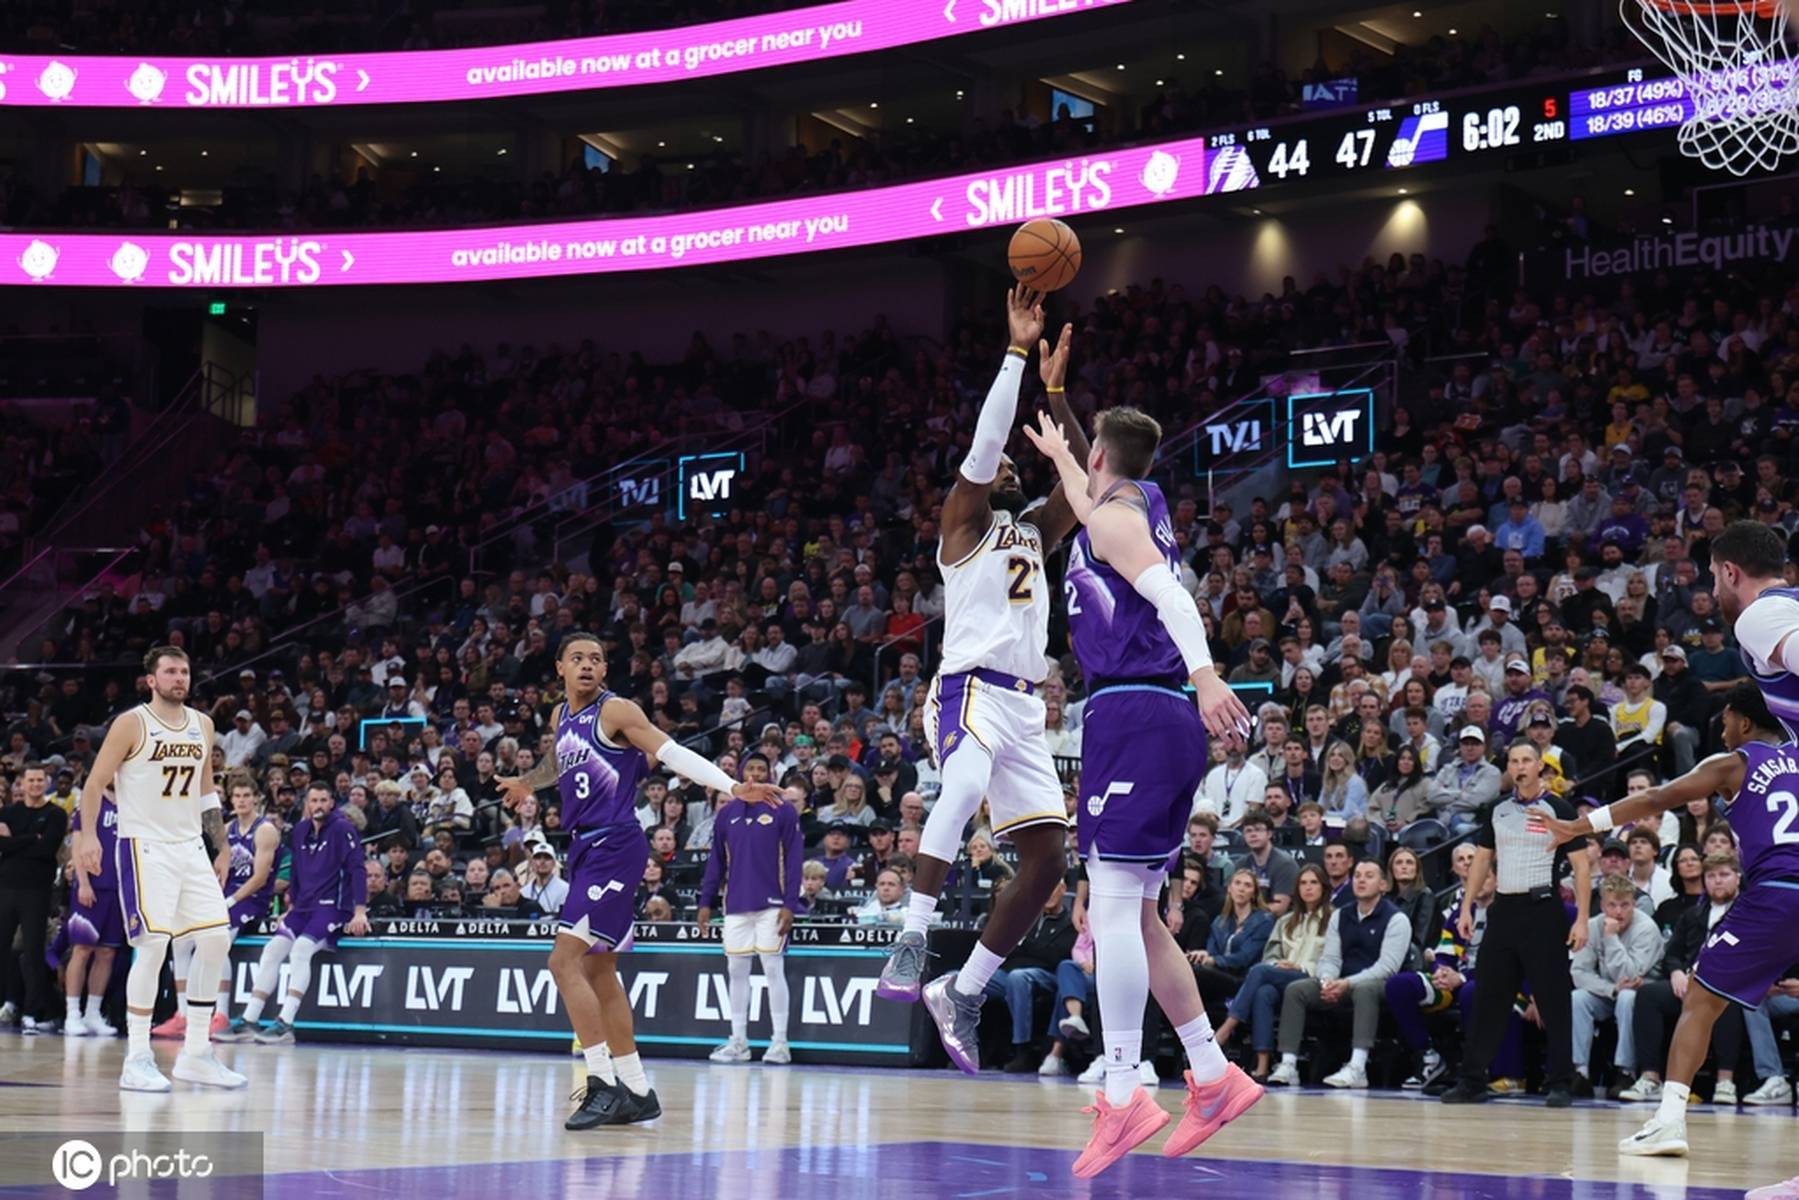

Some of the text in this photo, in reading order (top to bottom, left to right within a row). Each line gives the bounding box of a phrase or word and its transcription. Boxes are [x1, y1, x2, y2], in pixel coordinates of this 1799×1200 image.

[467, 20, 862, 85] available now at a grocer near you
[1628, 69, 1643, 82] FG
[1544, 98, 1556, 118] 5
[1588, 85, 1634, 109] 18/37
[1637, 79, 1684, 104] (49%)
[1462, 105, 1520, 151] 6:02
[1534, 121, 1565, 141] 2ND
[1586, 111, 1635, 134] 18/39
[1637, 104, 1684, 128] (46%)
[1219, 134, 1236, 146] FLS
[1336, 129, 1376, 168] 47
[1268, 139, 1310, 178] 44
[452, 214, 849, 266] available now at a grocer near you
[1565, 225, 1793, 279] HealthEquity
[1303, 409, 1361, 446] LVT
[690, 470, 735, 500] LVT
[148, 740, 203, 761] LAKERS
[162, 765, 197, 798] 77
[575, 772, 590, 799] 3
[1747, 757, 1799, 795] SENSAB
[400, 922, 440, 933] DELTA
[468, 923, 510, 934] DELTA
[633, 926, 658, 937] LTA
[792, 929, 819, 940] LTA
[317, 963, 384, 1007] LVT
[405, 966, 475, 1011] LVT
[616, 972, 669, 1018] VT
[802, 976, 880, 1025] LVT
